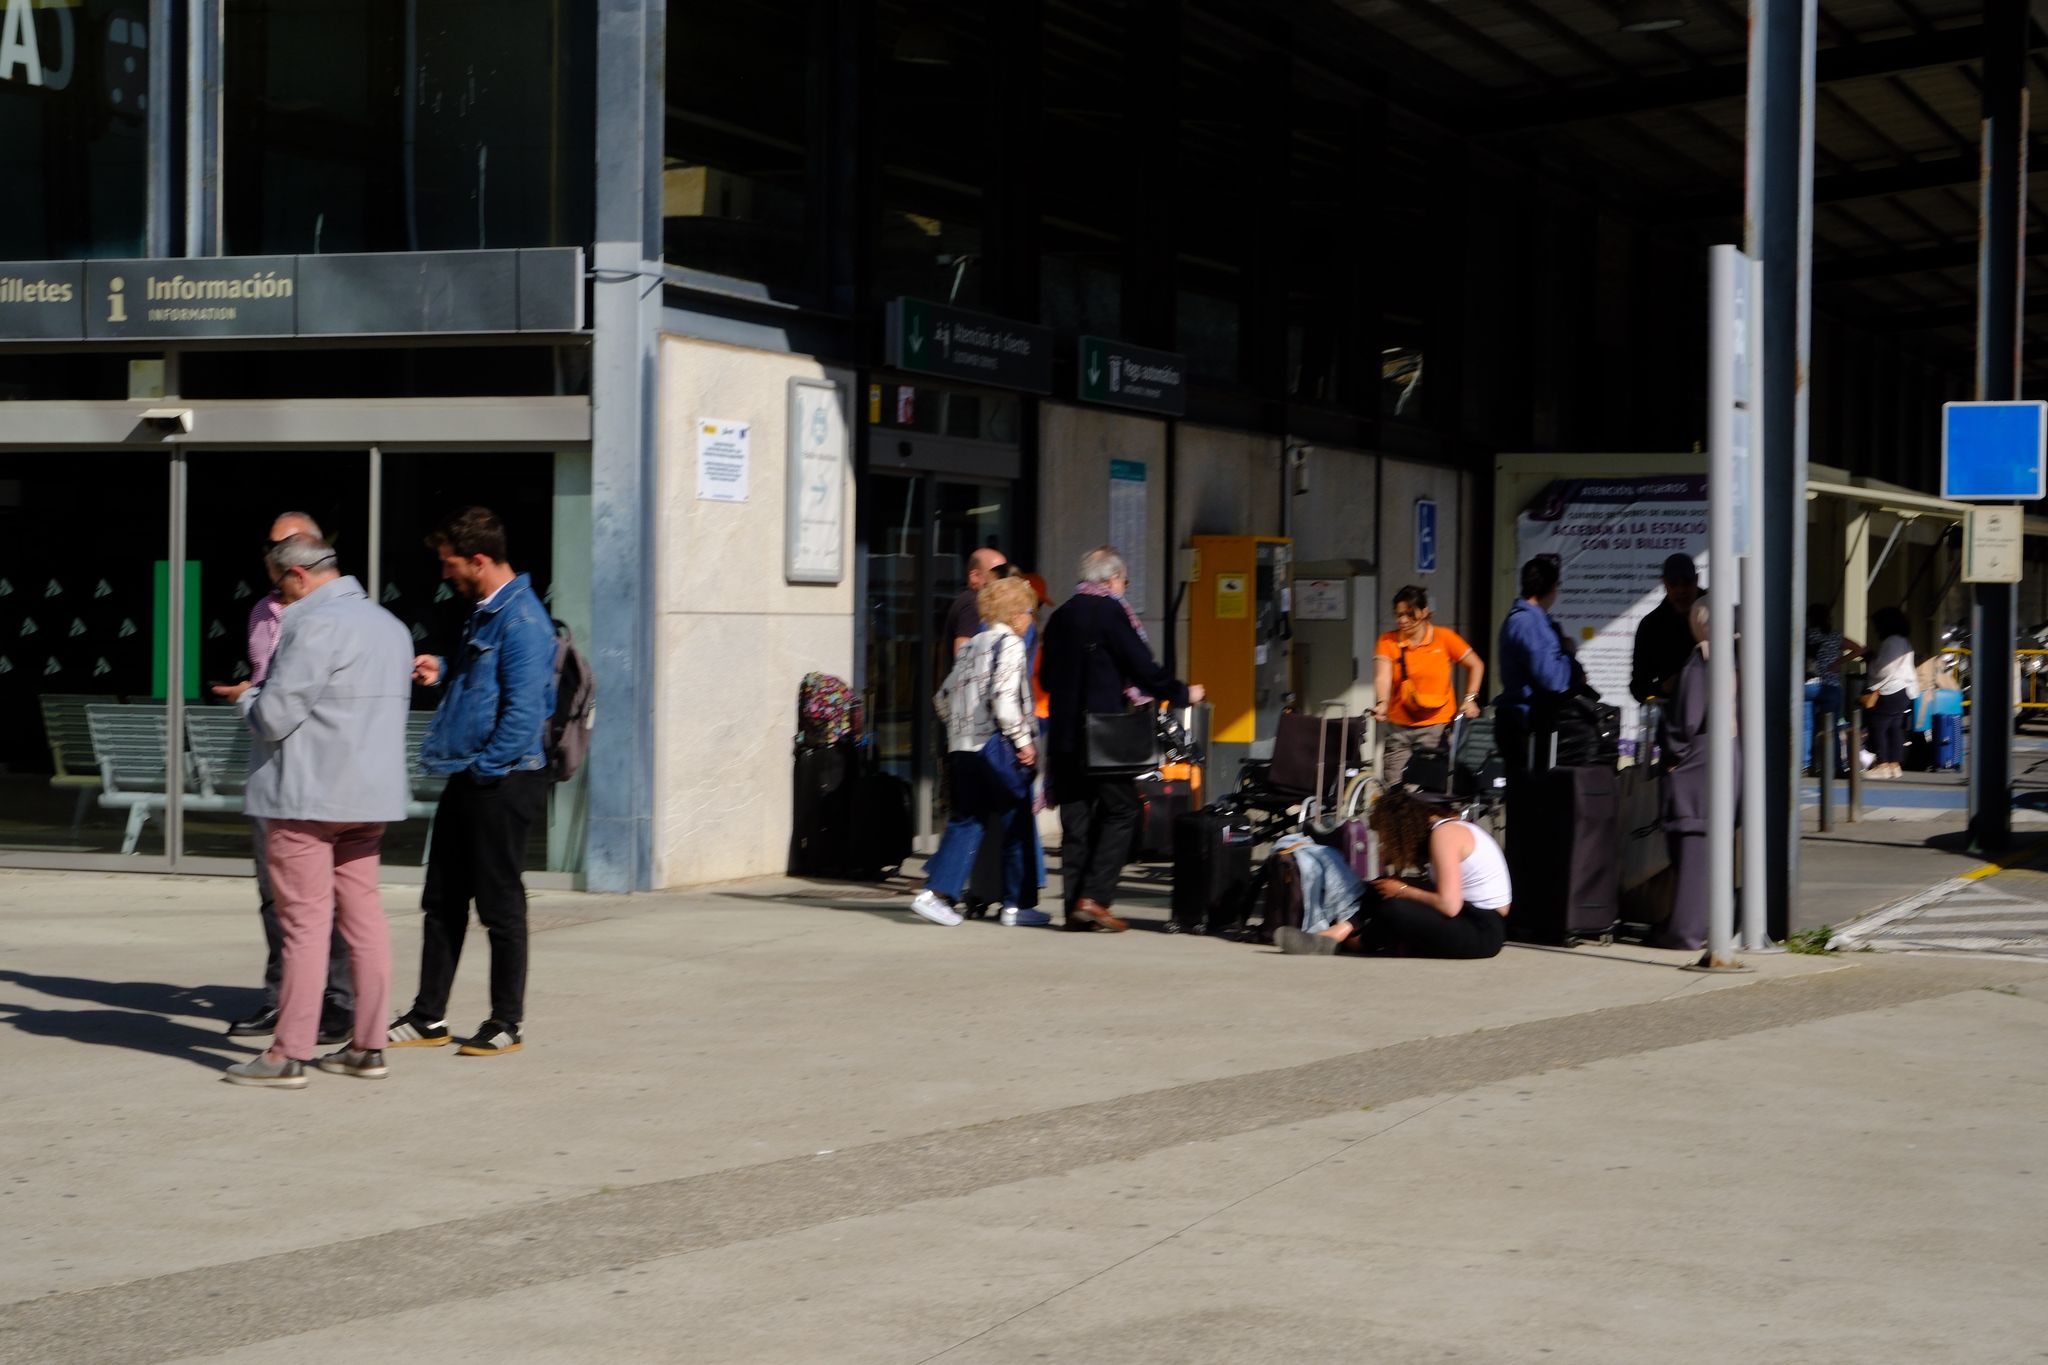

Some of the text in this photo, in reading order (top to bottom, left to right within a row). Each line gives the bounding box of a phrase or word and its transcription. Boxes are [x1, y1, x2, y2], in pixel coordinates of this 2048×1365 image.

[0, 277, 73, 302] illetes
[147, 271, 293, 300] Información
[148, 307, 237, 321] INFORMATION
[1629, 523, 1648, 534] LA
[1650, 519, 1708, 535] ESTACIÓ
[1612, 538, 1632, 550] SU
[1636, 537, 1688, 550] BILLETE
